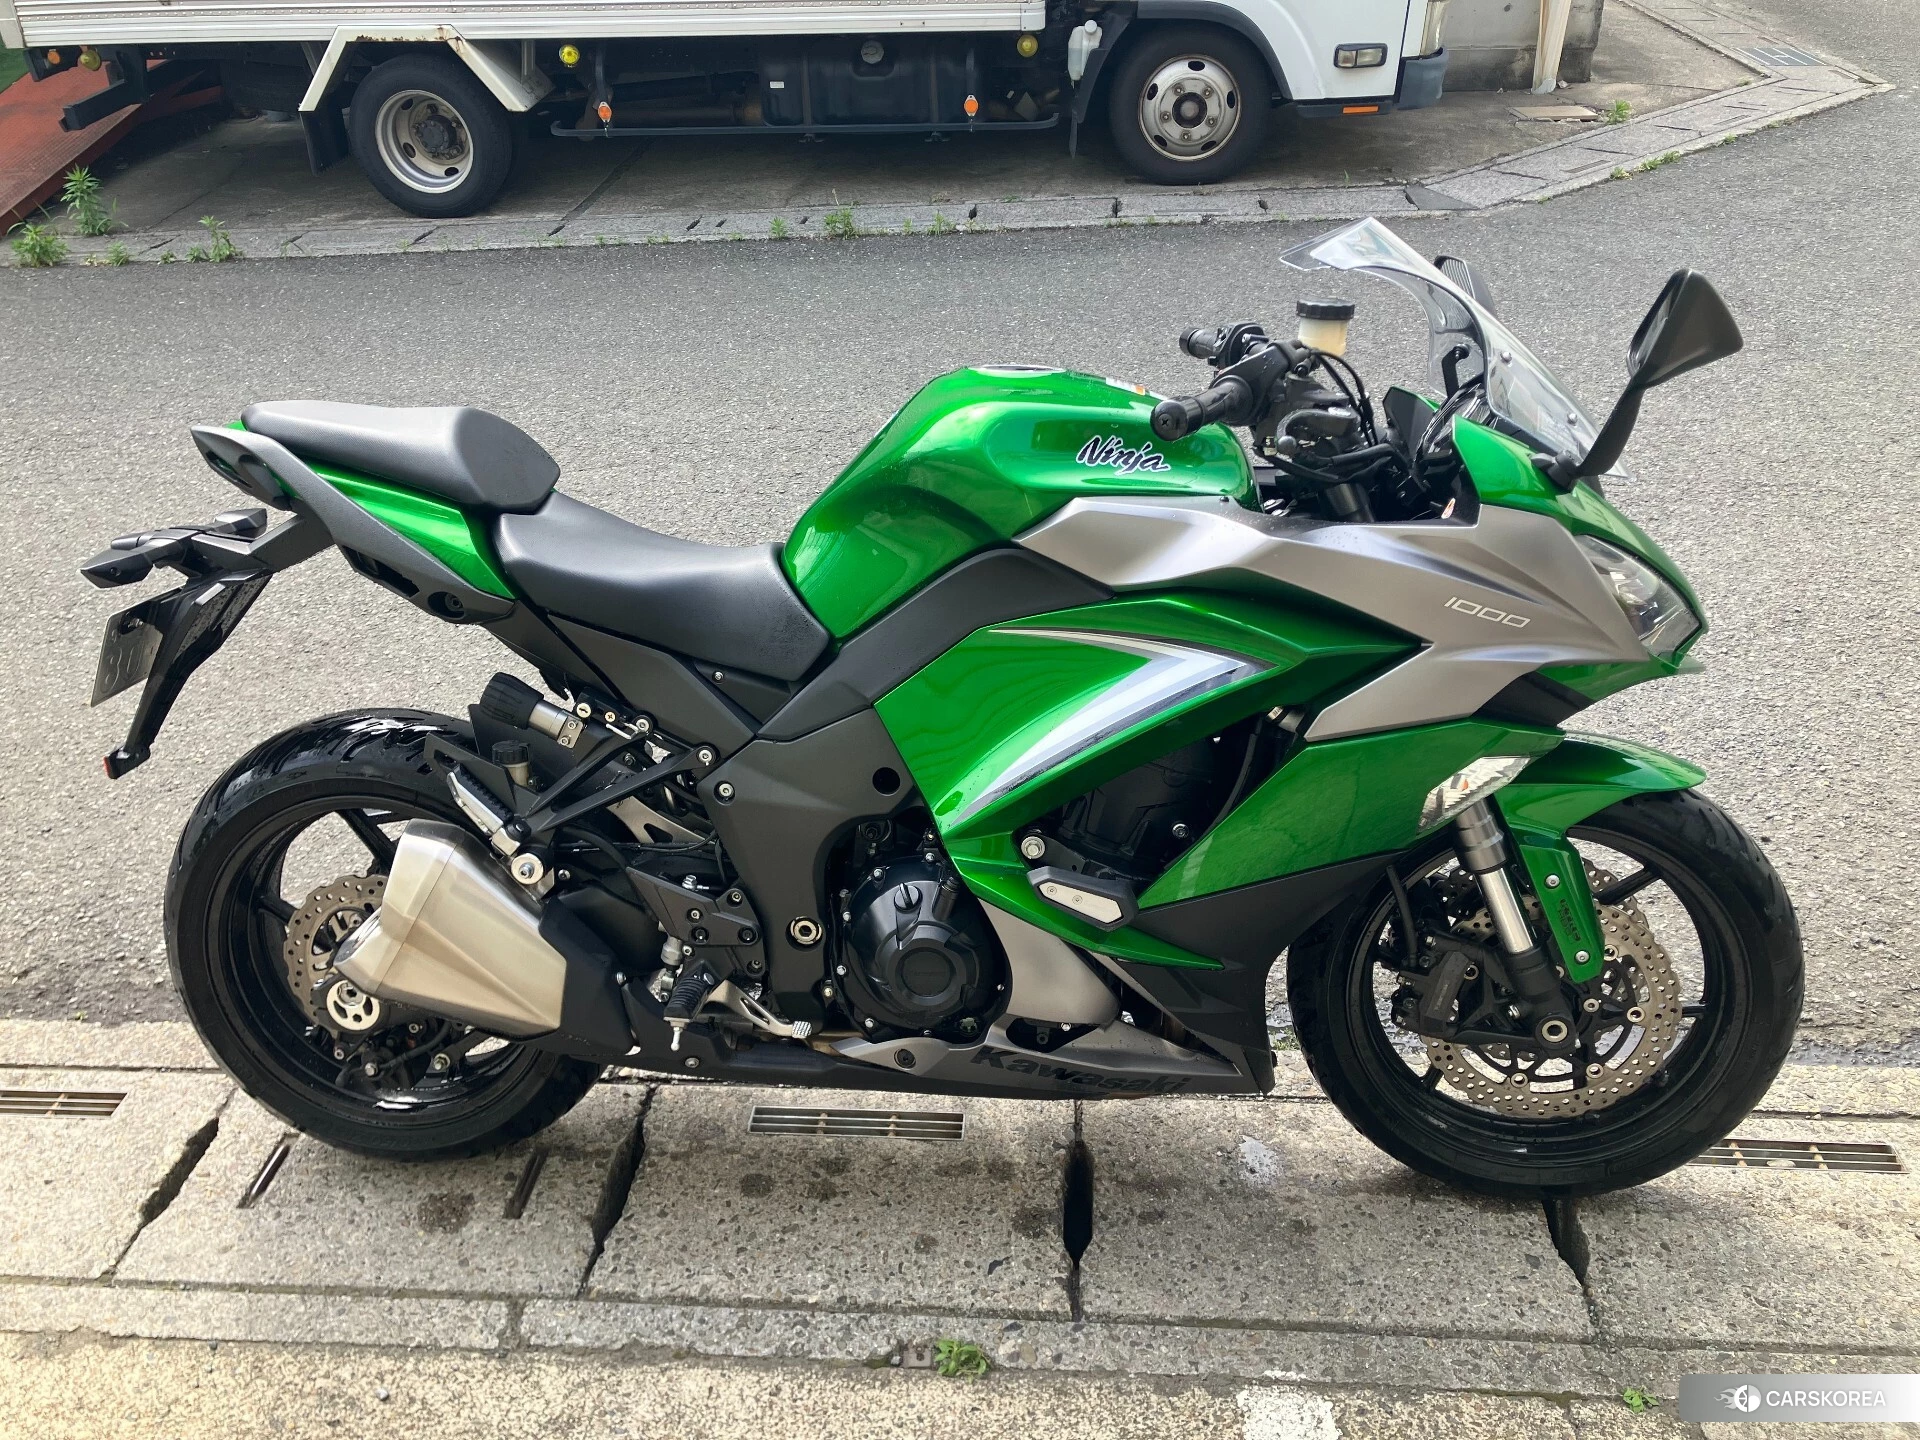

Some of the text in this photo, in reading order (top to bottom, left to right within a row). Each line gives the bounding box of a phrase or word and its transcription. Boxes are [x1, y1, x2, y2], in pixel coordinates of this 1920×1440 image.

[1076, 434, 1171, 476] Ninja
[1444, 596, 1531, 628] 1000
[969, 1045, 1192, 1093] Kawasaki
